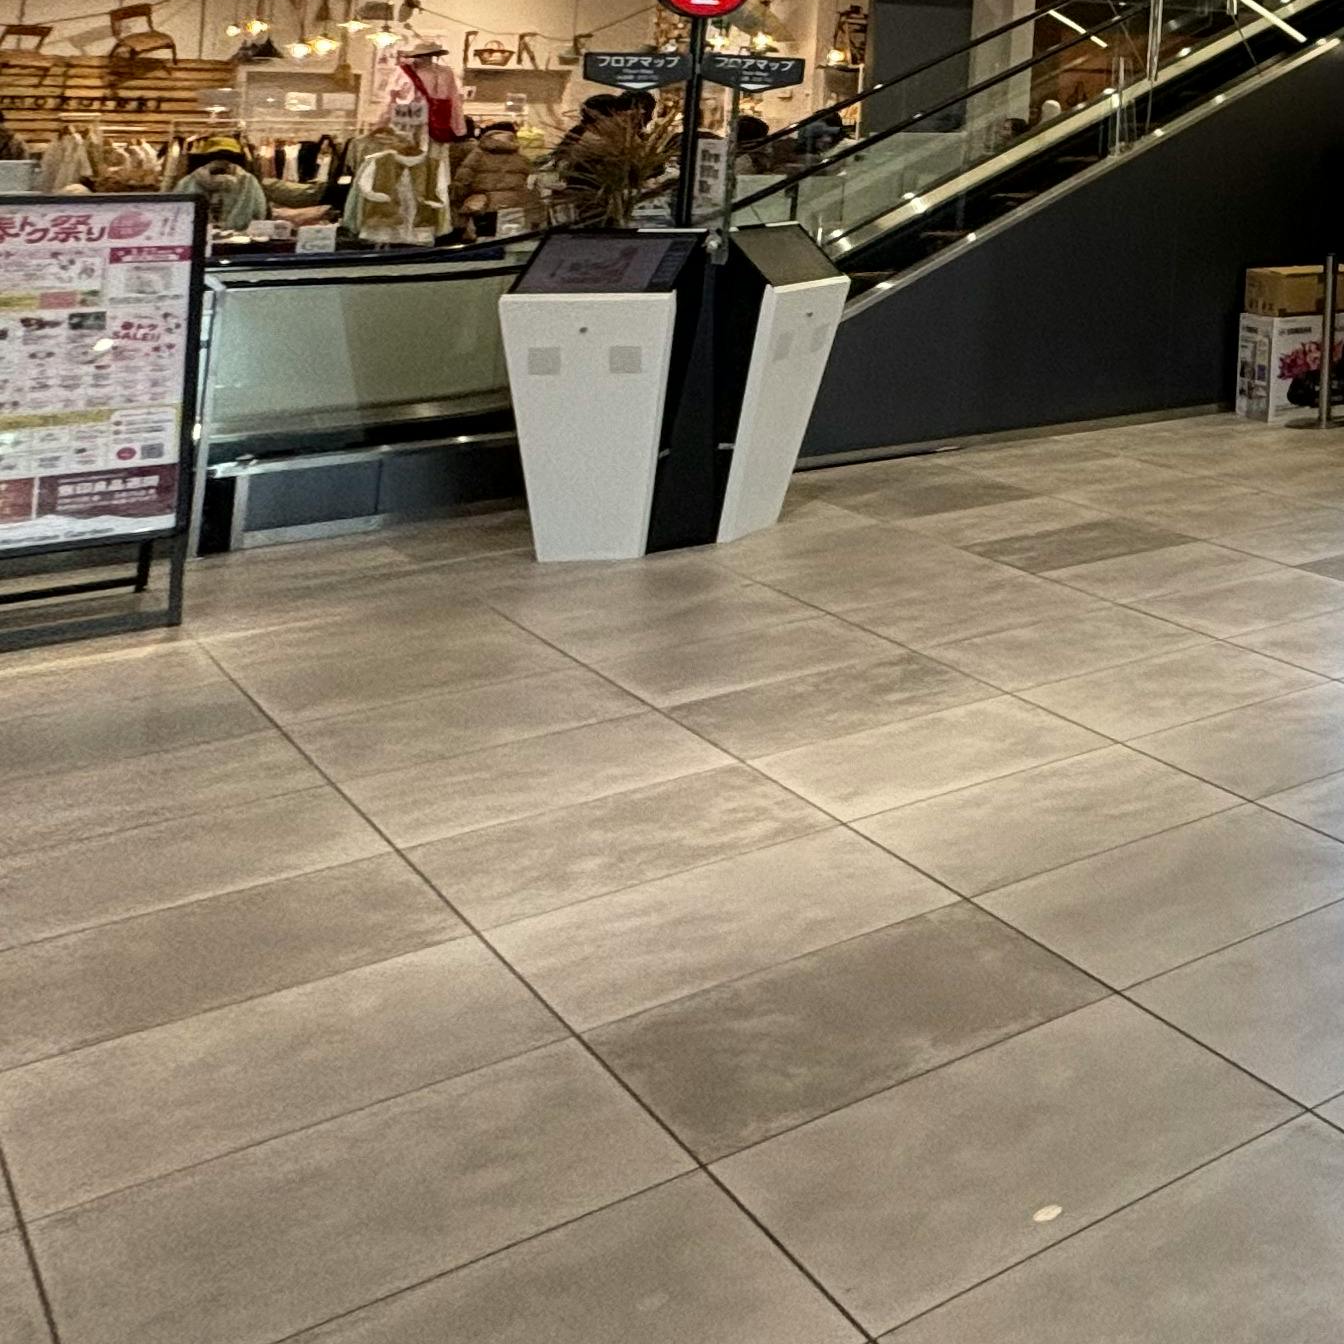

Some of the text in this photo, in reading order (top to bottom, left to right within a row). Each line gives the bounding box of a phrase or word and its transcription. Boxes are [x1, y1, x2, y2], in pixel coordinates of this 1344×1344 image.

[598, 56, 680, 68] フロアマップ
